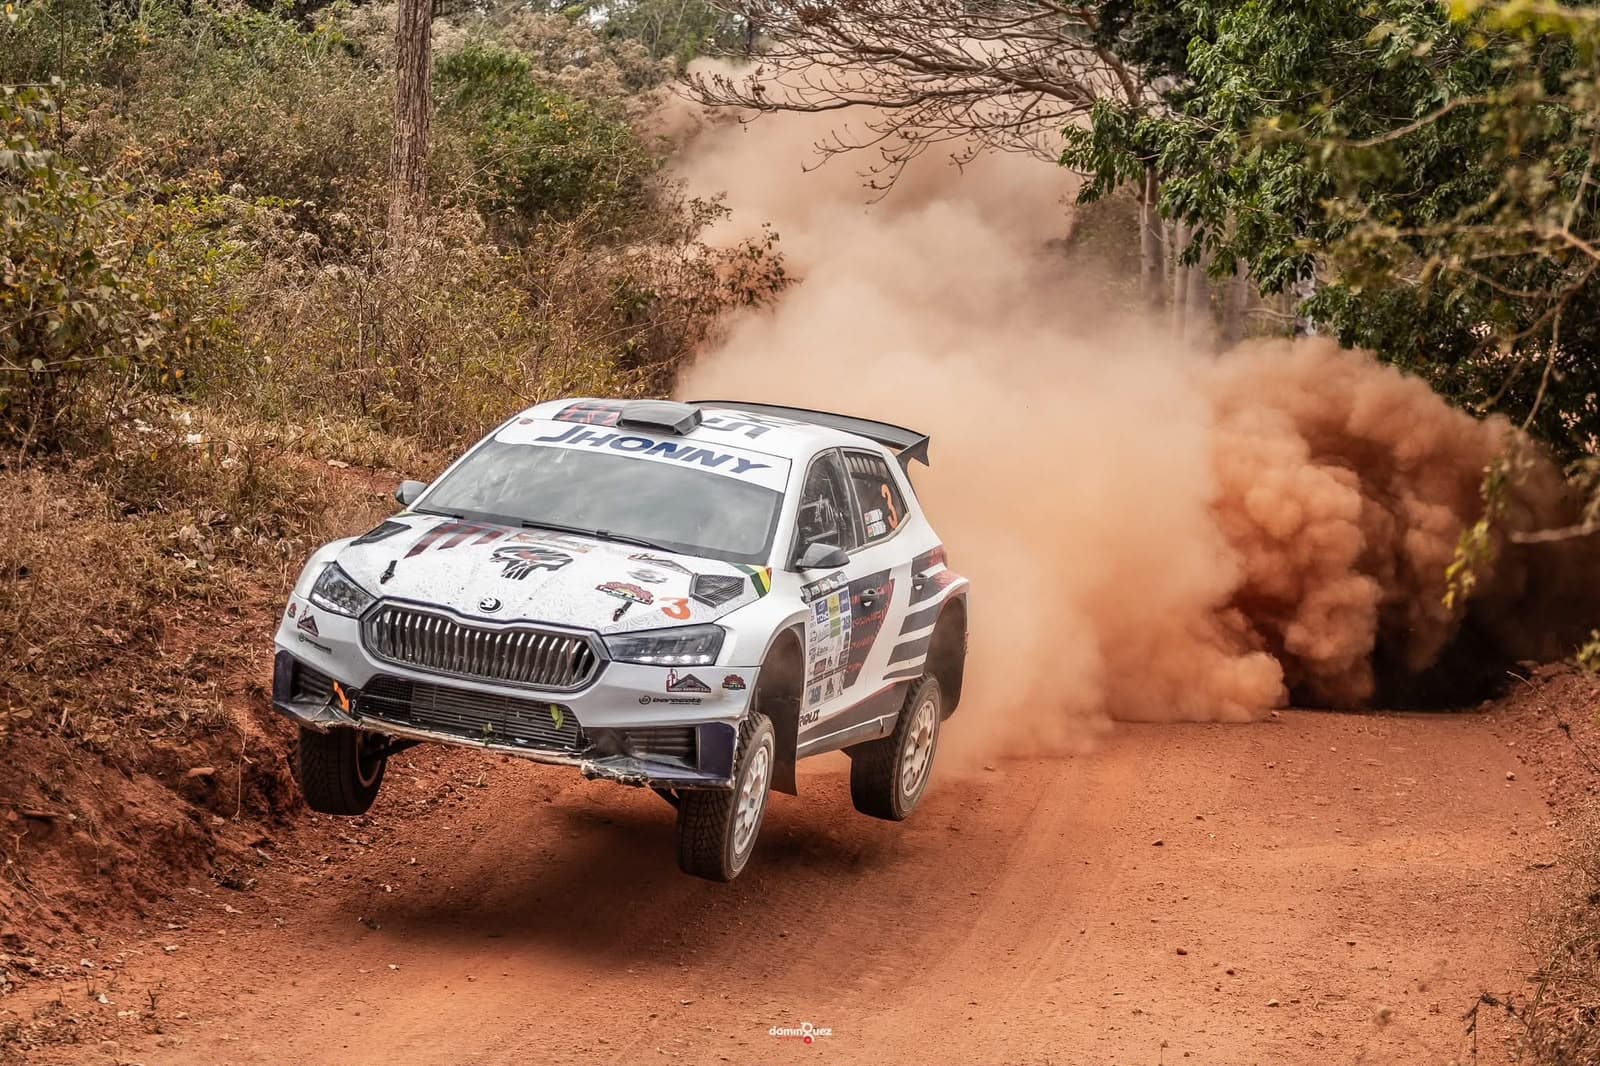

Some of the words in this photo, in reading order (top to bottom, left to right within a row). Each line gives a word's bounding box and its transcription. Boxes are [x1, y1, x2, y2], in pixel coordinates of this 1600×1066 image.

[534, 425, 772, 474] JHONNY
[881, 483, 898, 529] 3
[659, 596, 692, 620] 3
